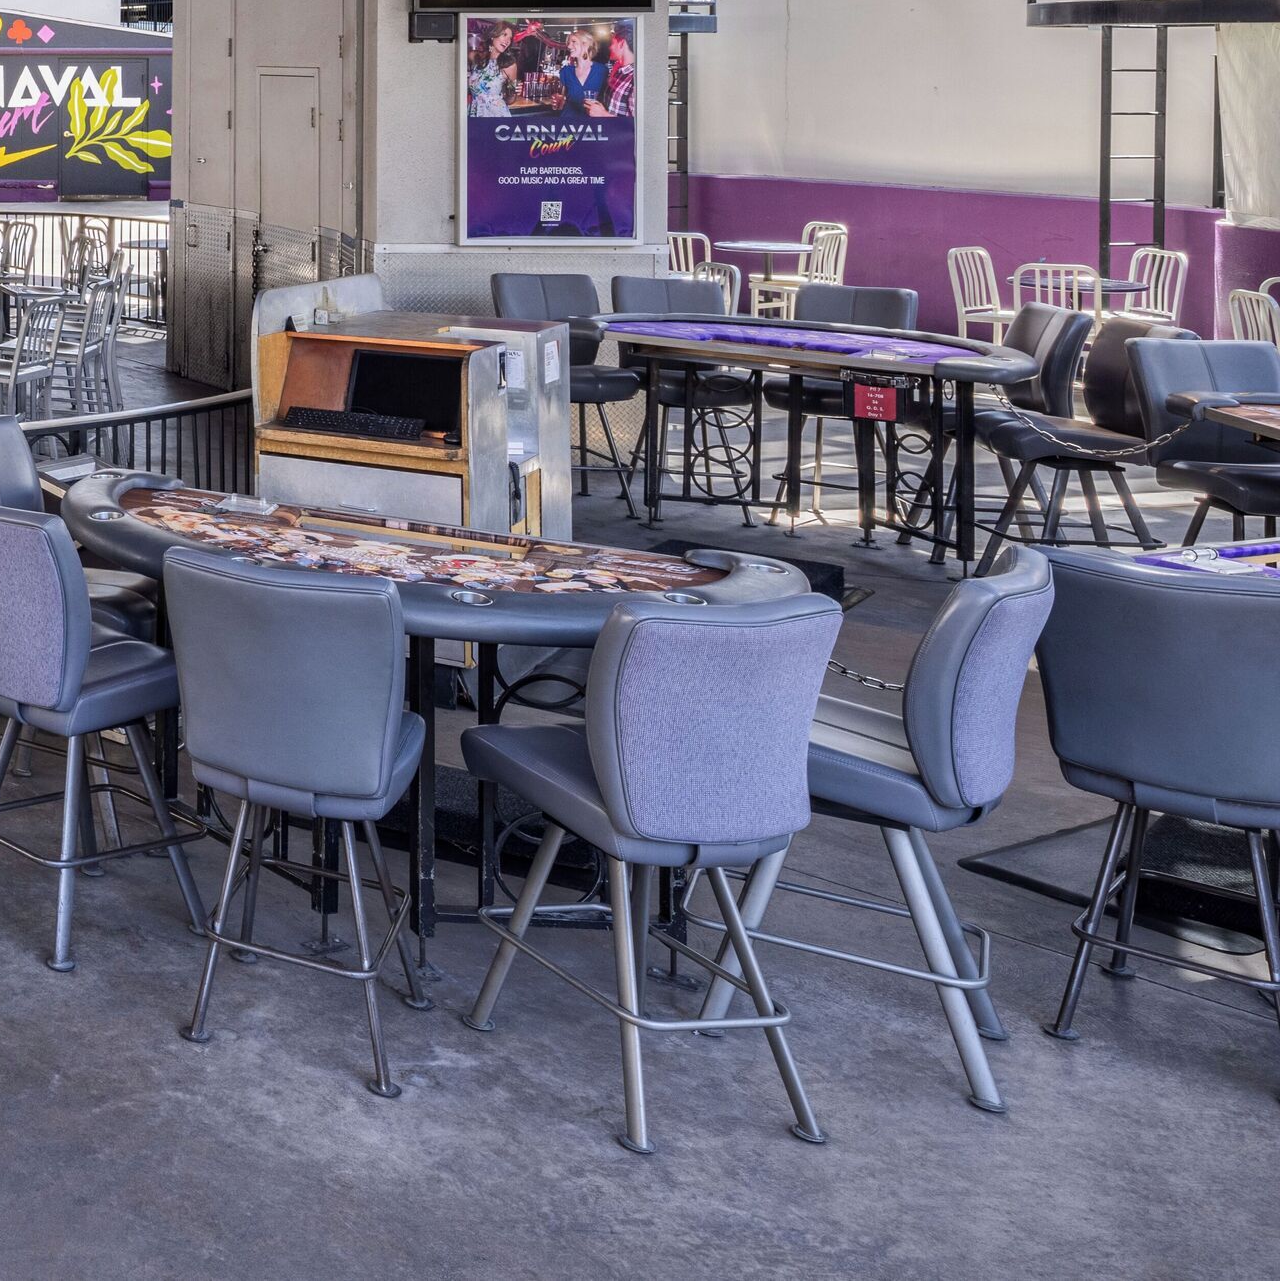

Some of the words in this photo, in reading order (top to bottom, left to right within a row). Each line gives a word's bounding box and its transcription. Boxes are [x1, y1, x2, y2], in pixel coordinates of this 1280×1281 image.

[495, 124, 609, 142] CARNAVAL
[529, 134, 576, 159] Court
[520, 167, 538, 175] FLAIR
[539, 167, 584, 176] BARTENDERS,
[498, 177, 520, 185] GOOD
[521, 177, 543, 185] MUSIC
[544, 177, 560, 185] AND
[560, 177, 566, 185] A
[567, 177, 589, 185] GREAT
[590, 177, 606, 185] TIME
